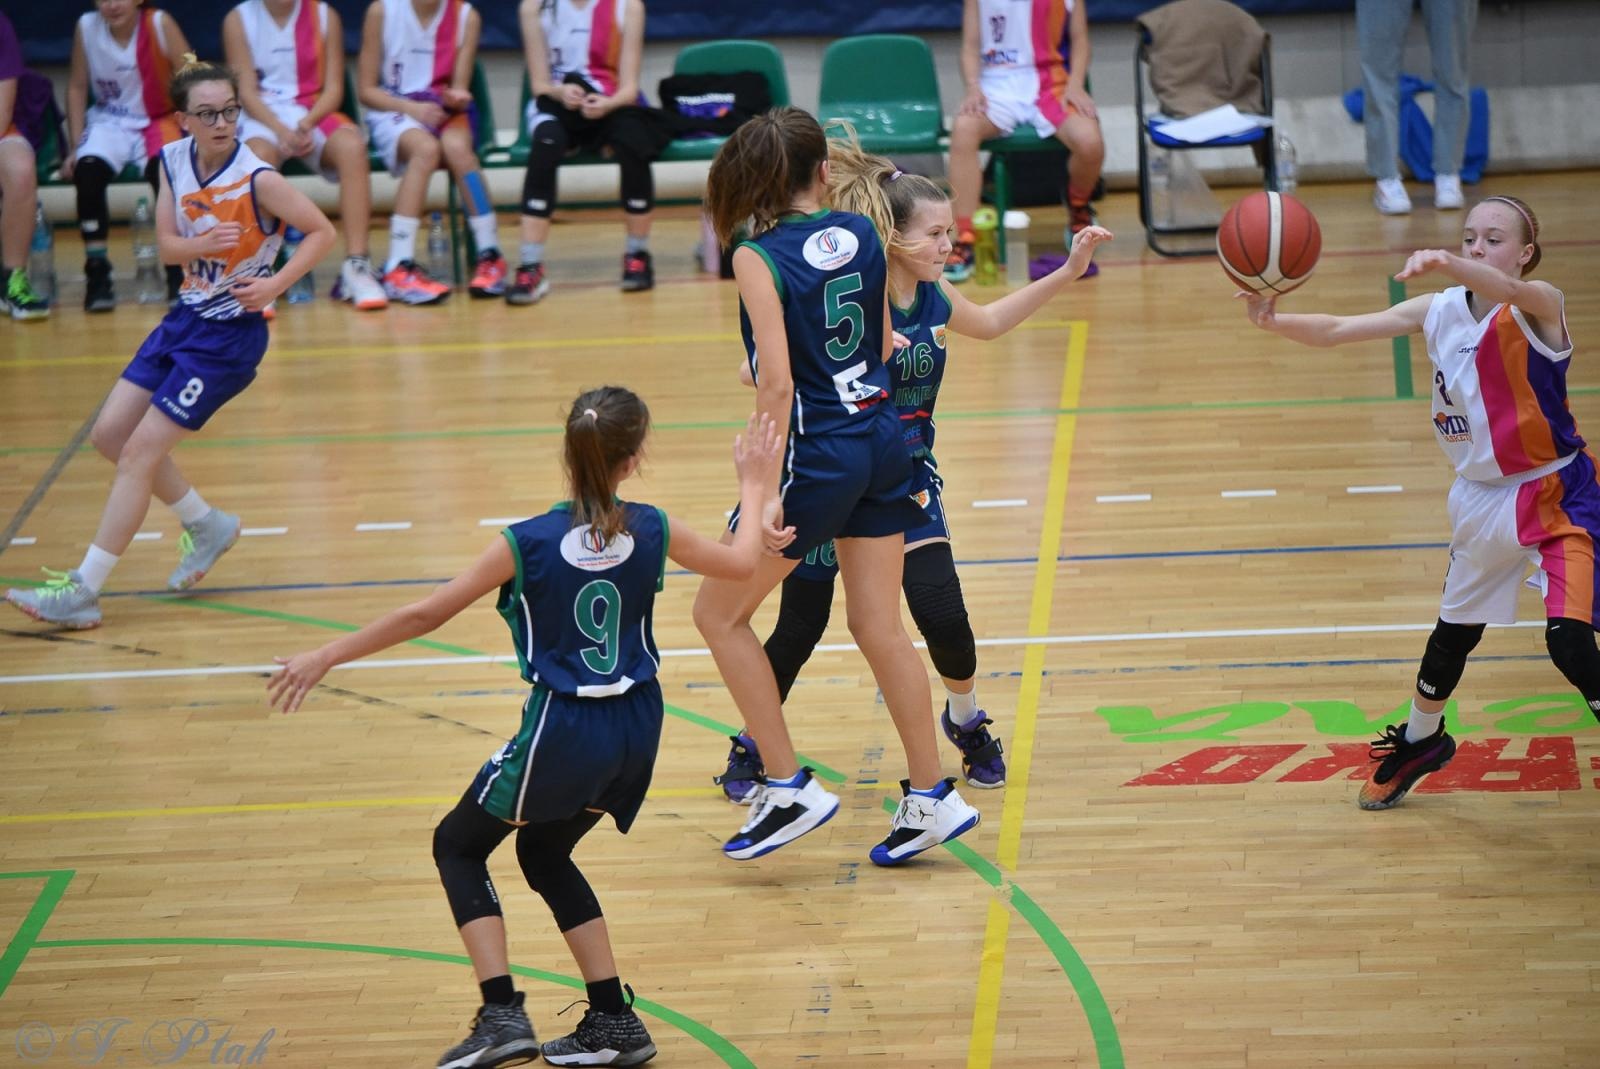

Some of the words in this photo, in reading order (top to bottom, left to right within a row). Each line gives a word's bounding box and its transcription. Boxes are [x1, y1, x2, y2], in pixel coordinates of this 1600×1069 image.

[824, 272, 863, 361] 5
[896, 342, 935, 380] 16
[179, 377, 204, 407] 8
[1435, 370, 1453, 407] 2
[574, 579, 622, 674] 9
